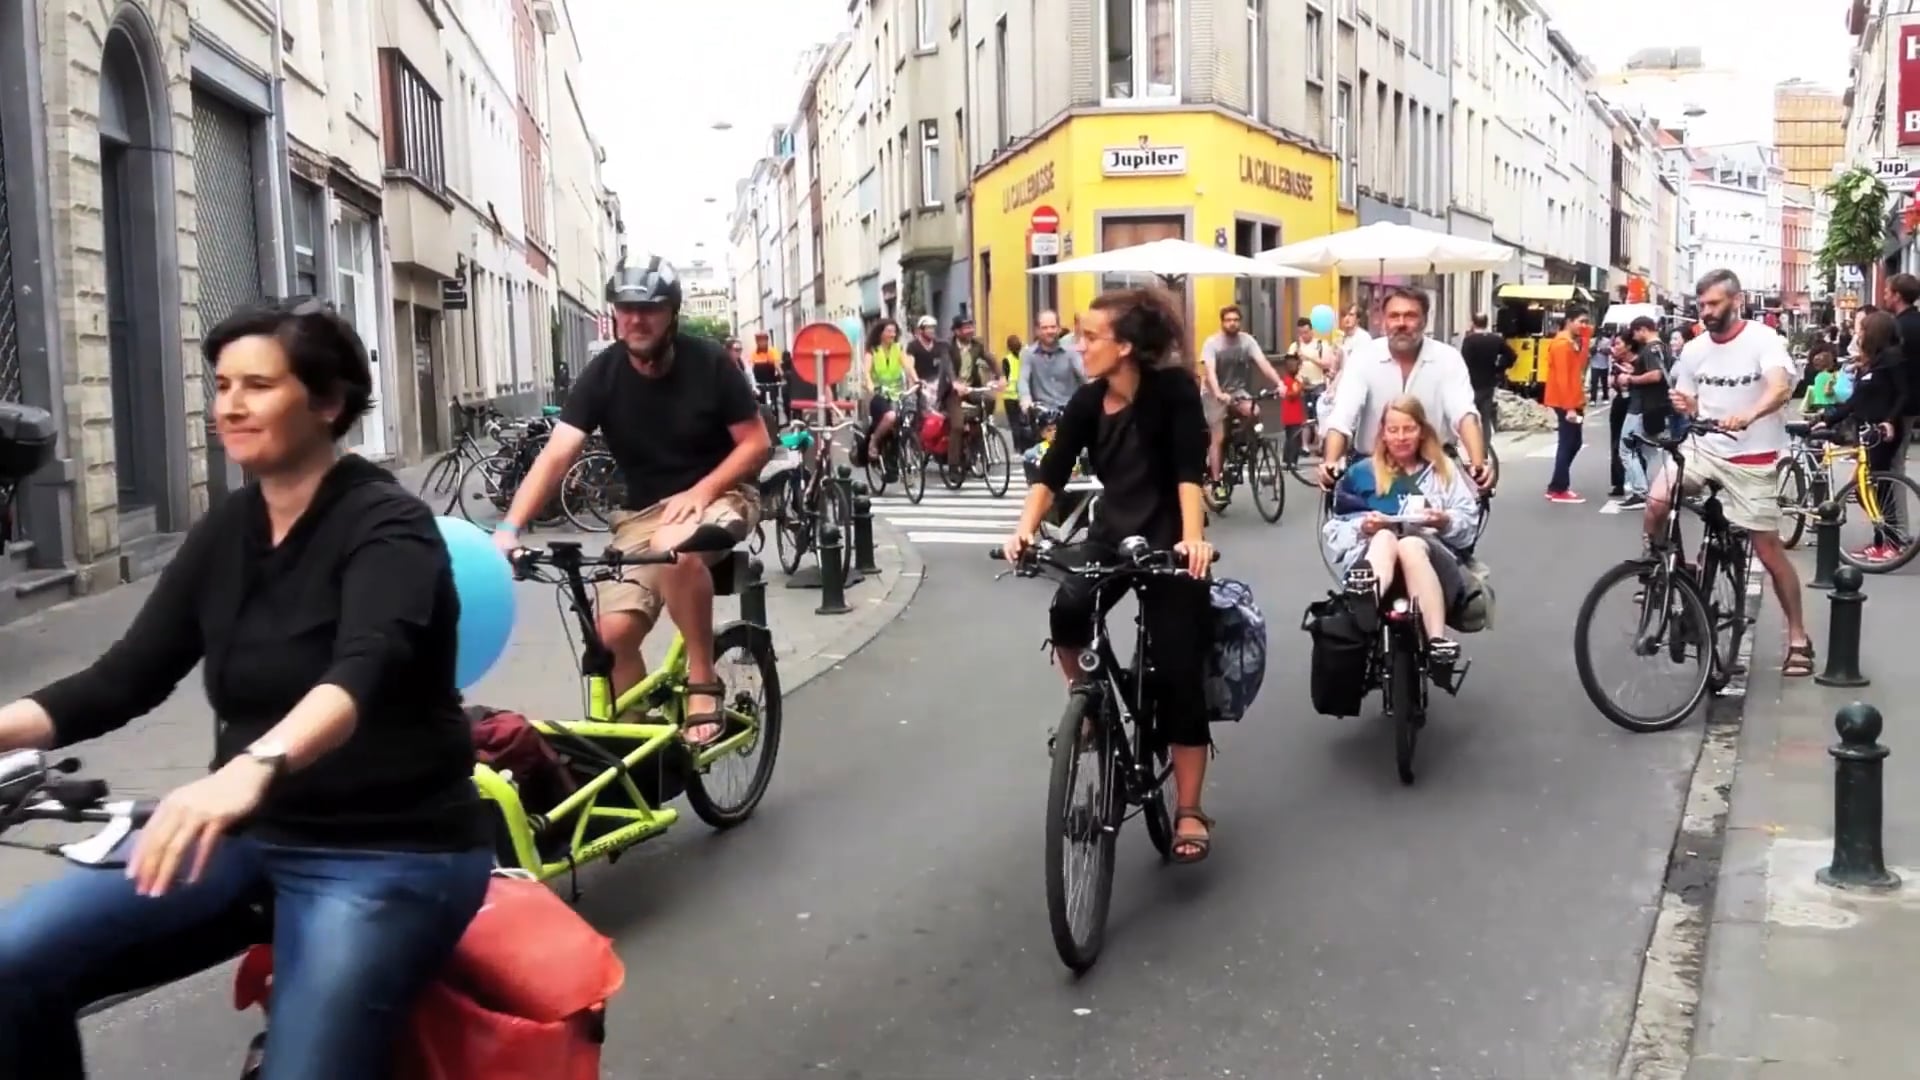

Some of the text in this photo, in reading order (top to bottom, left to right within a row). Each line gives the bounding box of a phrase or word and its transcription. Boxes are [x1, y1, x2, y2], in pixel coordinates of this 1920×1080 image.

[1111, 150, 1179, 169] Jupiler
[1239, 153, 1313, 201] LA CALLEBASSE
